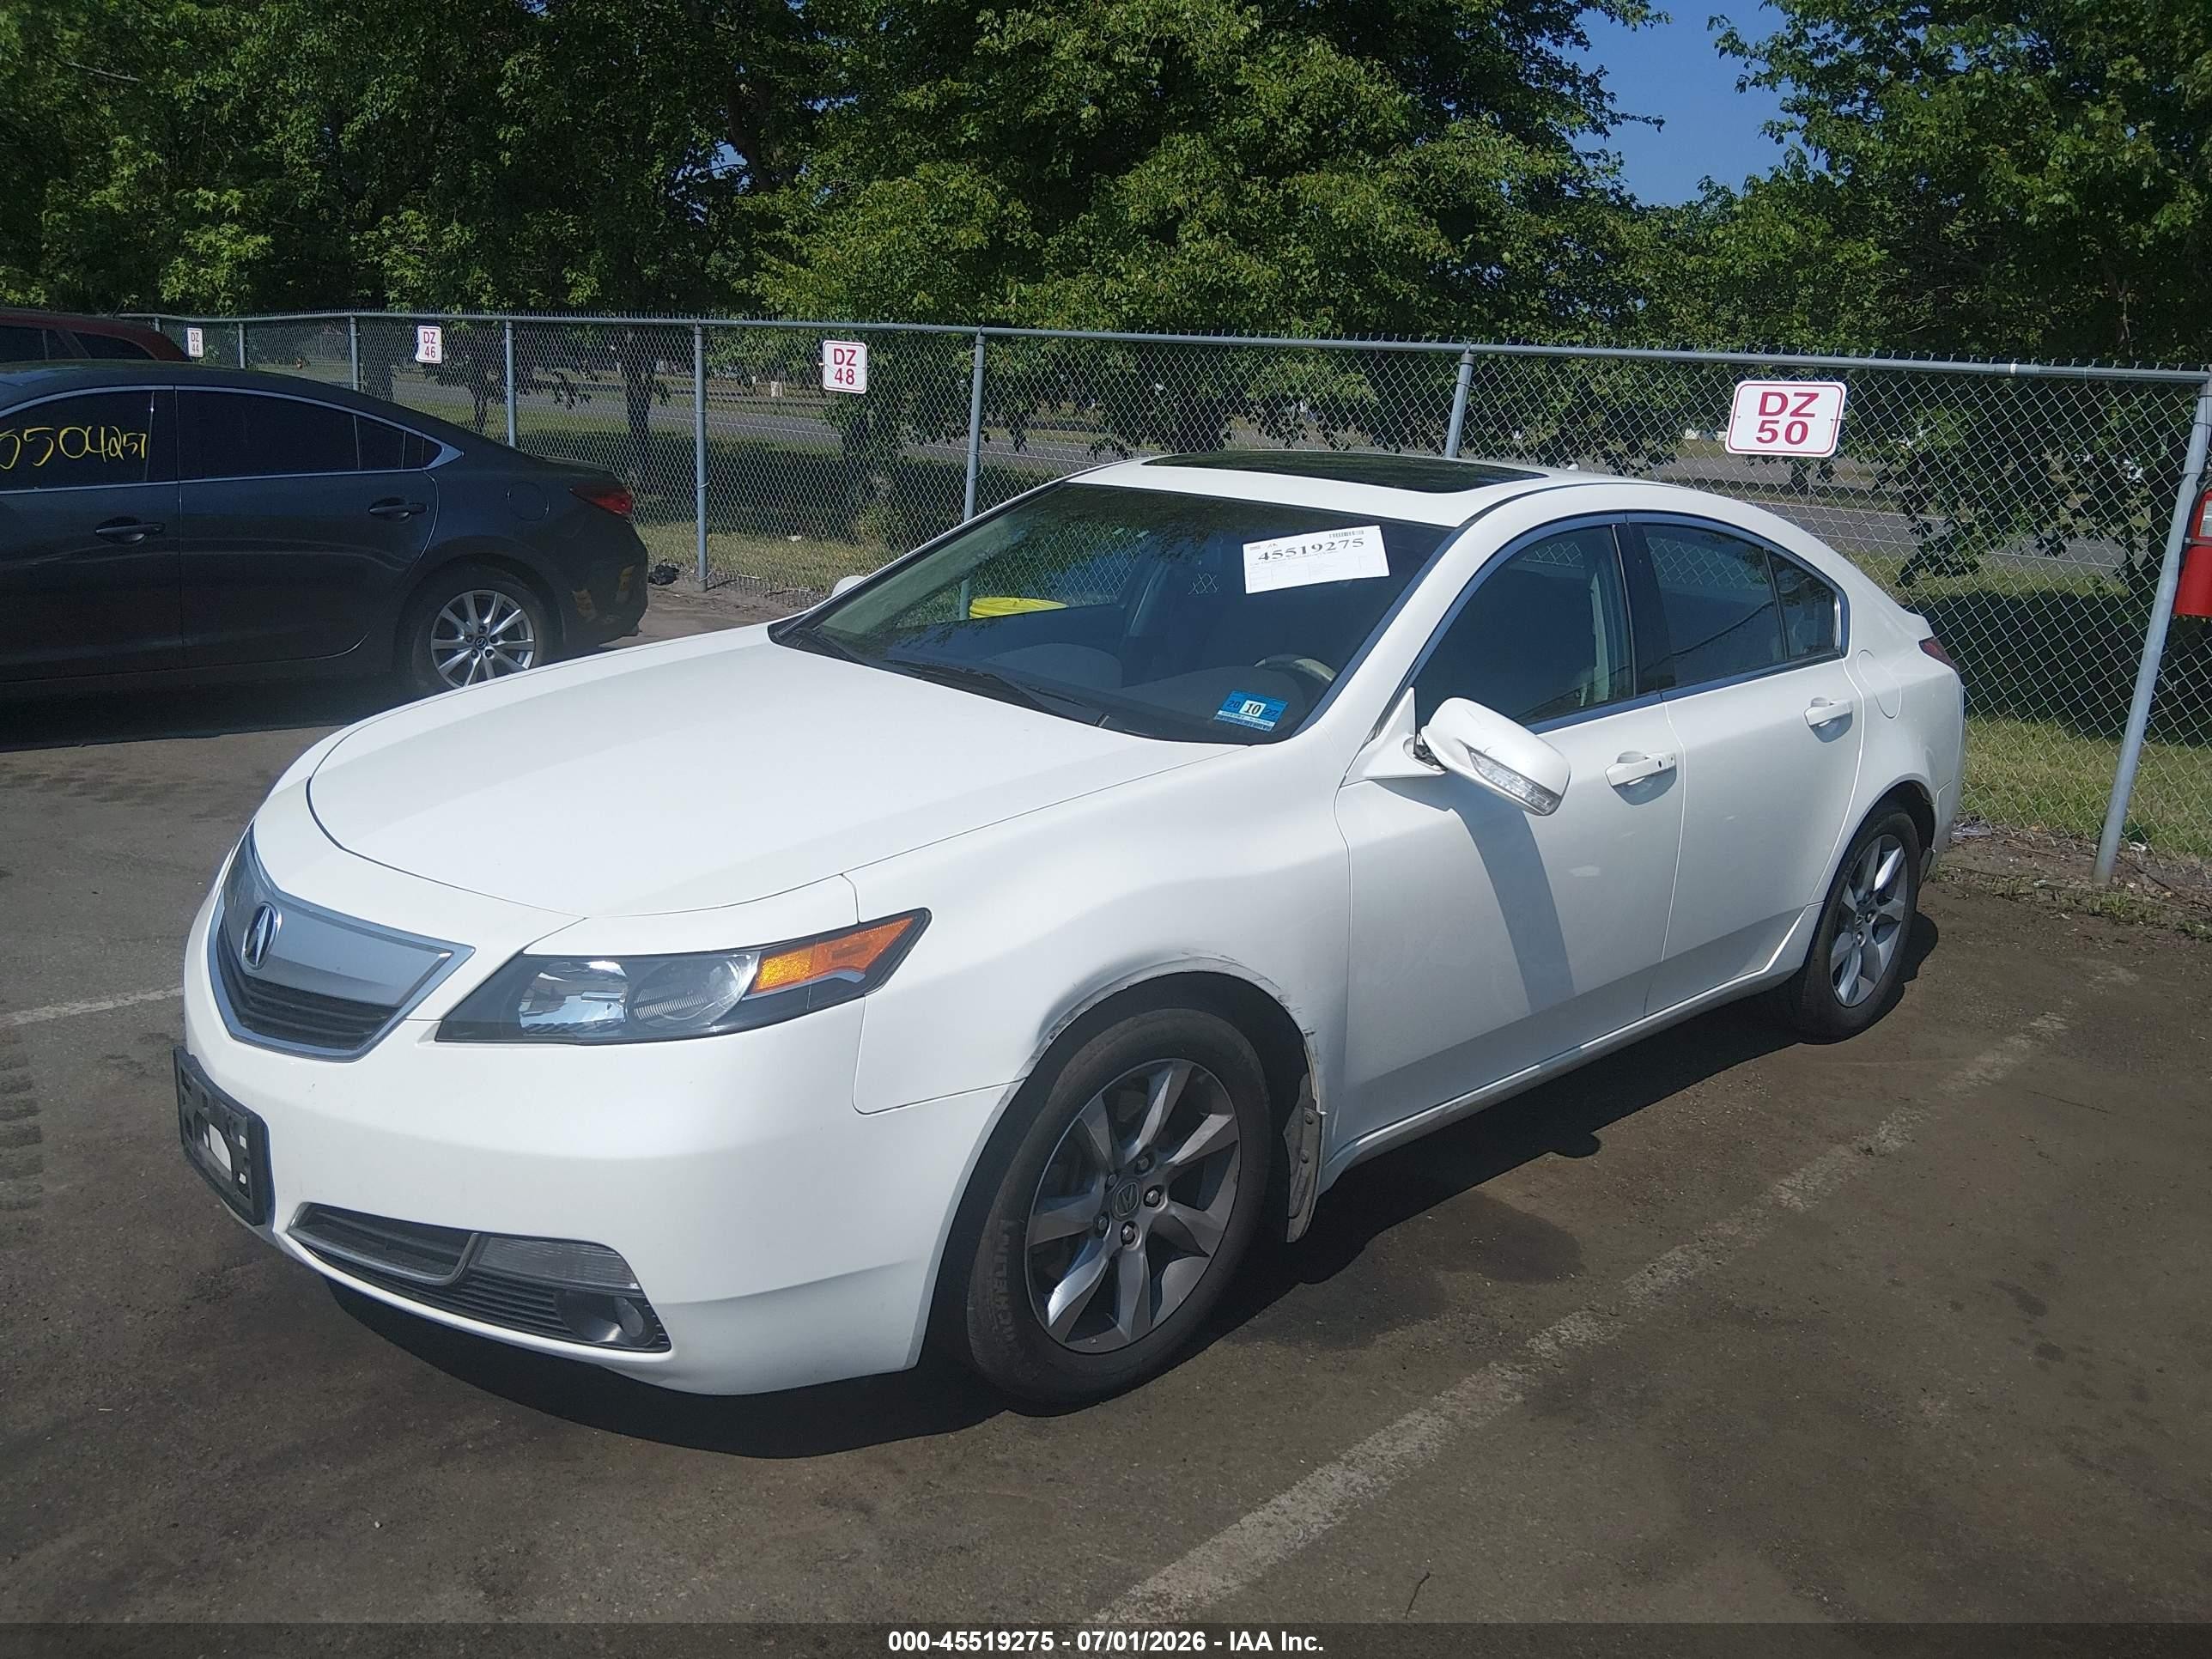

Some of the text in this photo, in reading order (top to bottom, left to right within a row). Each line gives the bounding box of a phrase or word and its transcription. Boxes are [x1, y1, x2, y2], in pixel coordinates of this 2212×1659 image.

[191, 332, 199, 342] DZ
[423, 331, 436, 343] DZ
[425, 346, 435, 358] 46
[834, 348, 856, 367] DZ
[835, 368, 855, 385] 48
[1758, 392, 1820, 418] DZ
[1756, 419, 1808, 445] 50
[1258, 538, 1364, 561] 45519275
[1244, 703, 1261, 714] 10
